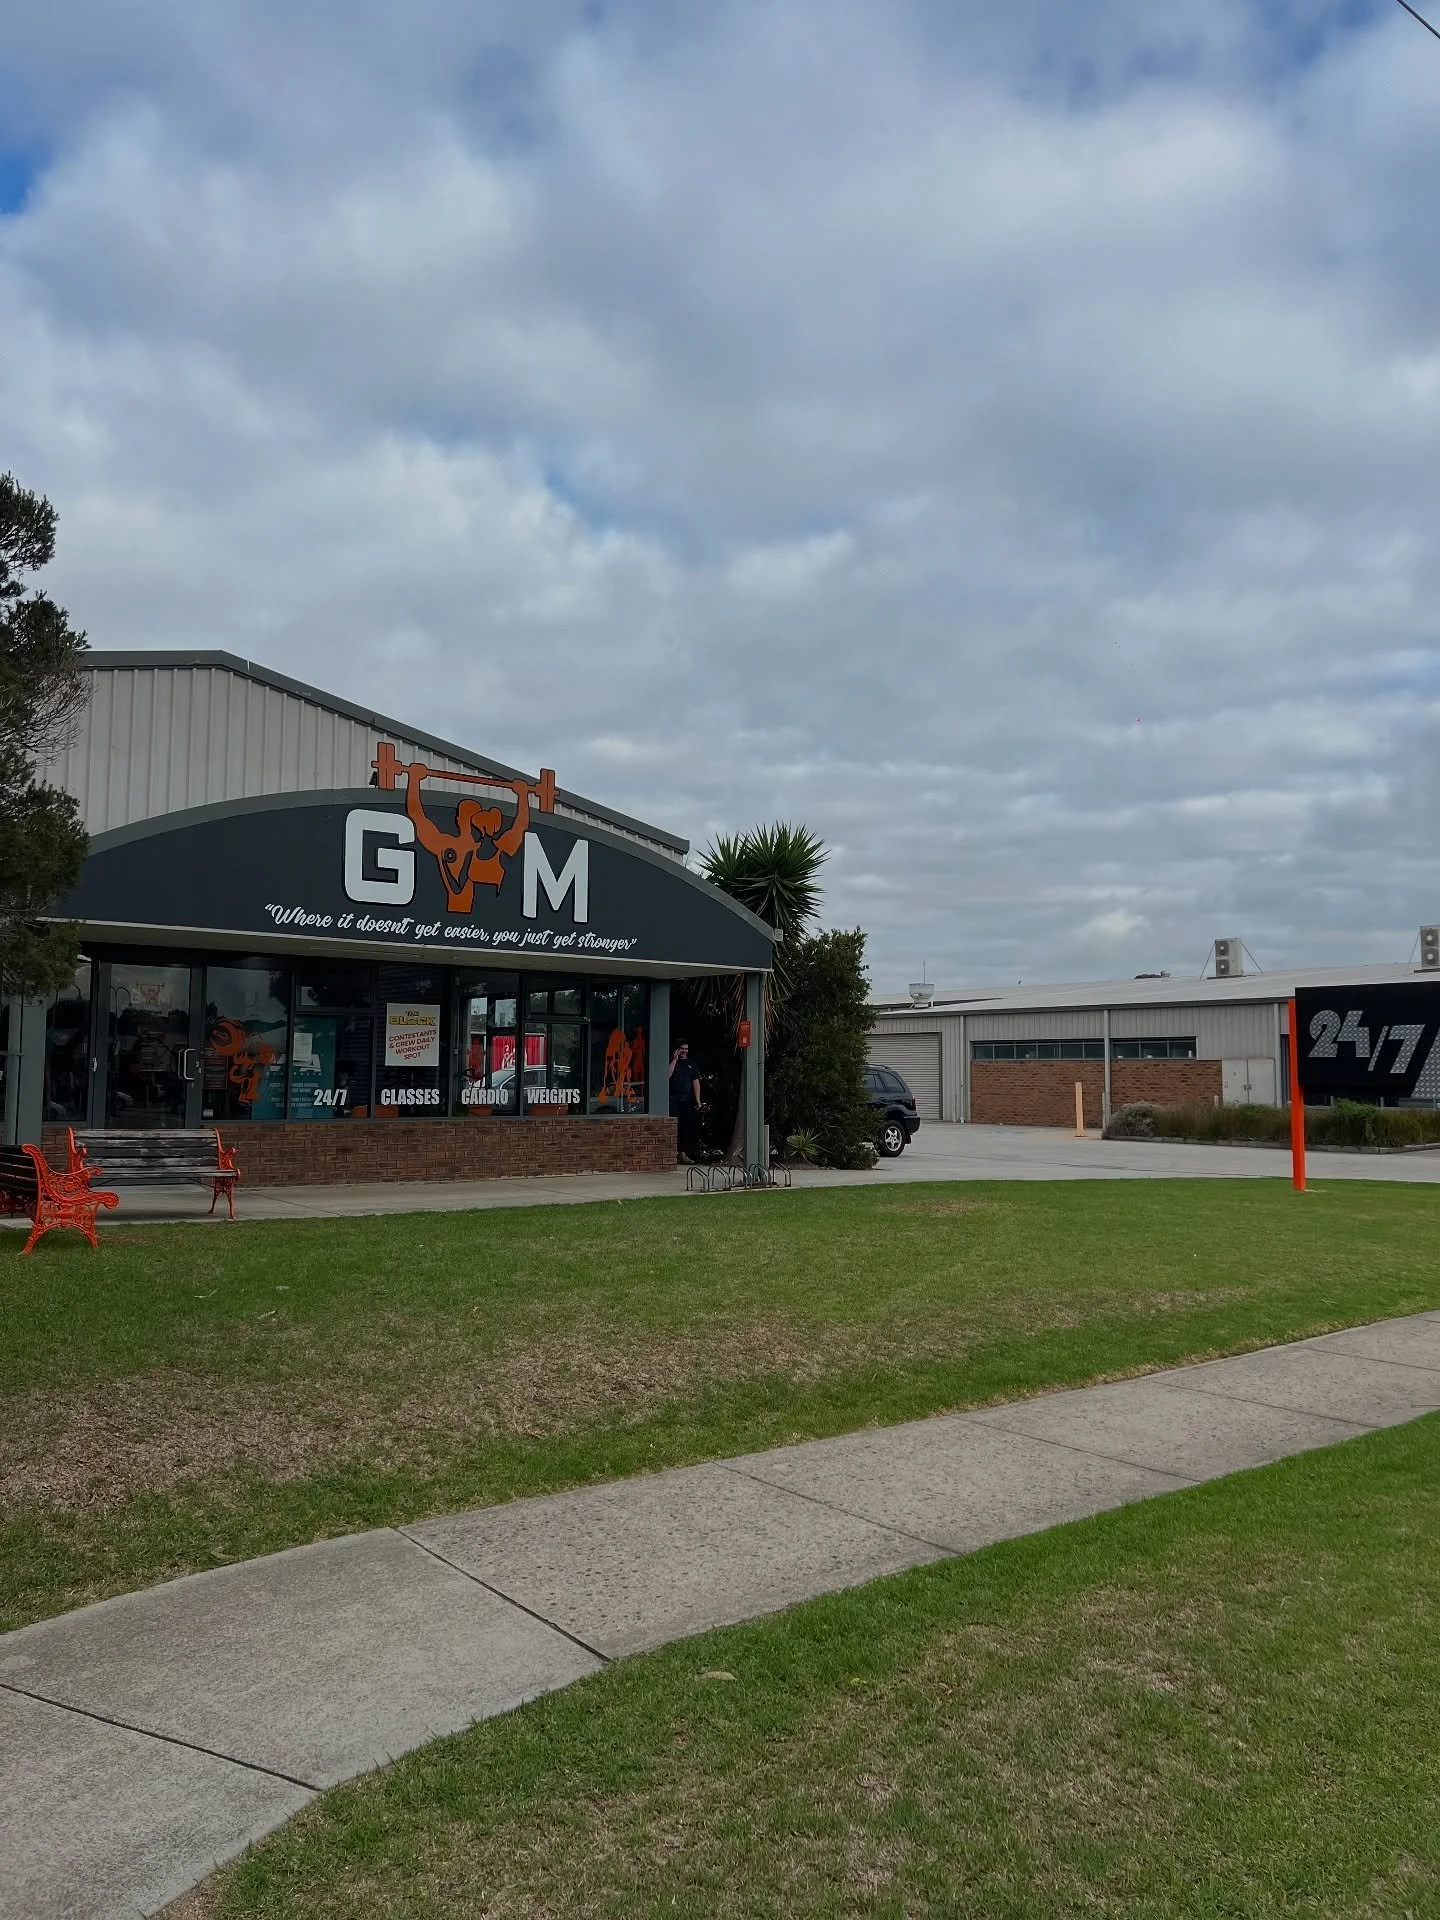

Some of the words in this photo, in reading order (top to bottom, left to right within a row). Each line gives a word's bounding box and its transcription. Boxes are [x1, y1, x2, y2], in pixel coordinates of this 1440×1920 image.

[337, 913, 355, 929] it
[414, 922, 442, 940] get
[444, 924, 490, 943] easier,
[491, 930, 521, 946] you
[517, 928, 555, 947] just
[552, 931, 577, 950] get
[389, 1016, 437, 1026] BLOCK
[388, 1029, 437, 1042] CONTESTANTS
[395, 1039, 416, 1048] CREW
[416, 1036, 436, 1045] DAILY
[1307, 1009, 1426, 1074] 24/7
[395, 1044, 431, 1055] WORKOUT
[403, 1051, 422, 1060] SPOT
[313, 1088, 348, 1106] 24/7
[380, 1088, 440, 1105] CLASSES
[461, 1088, 509, 1105] CARDIO
[527, 1088, 581, 1104] WEIGHTS
